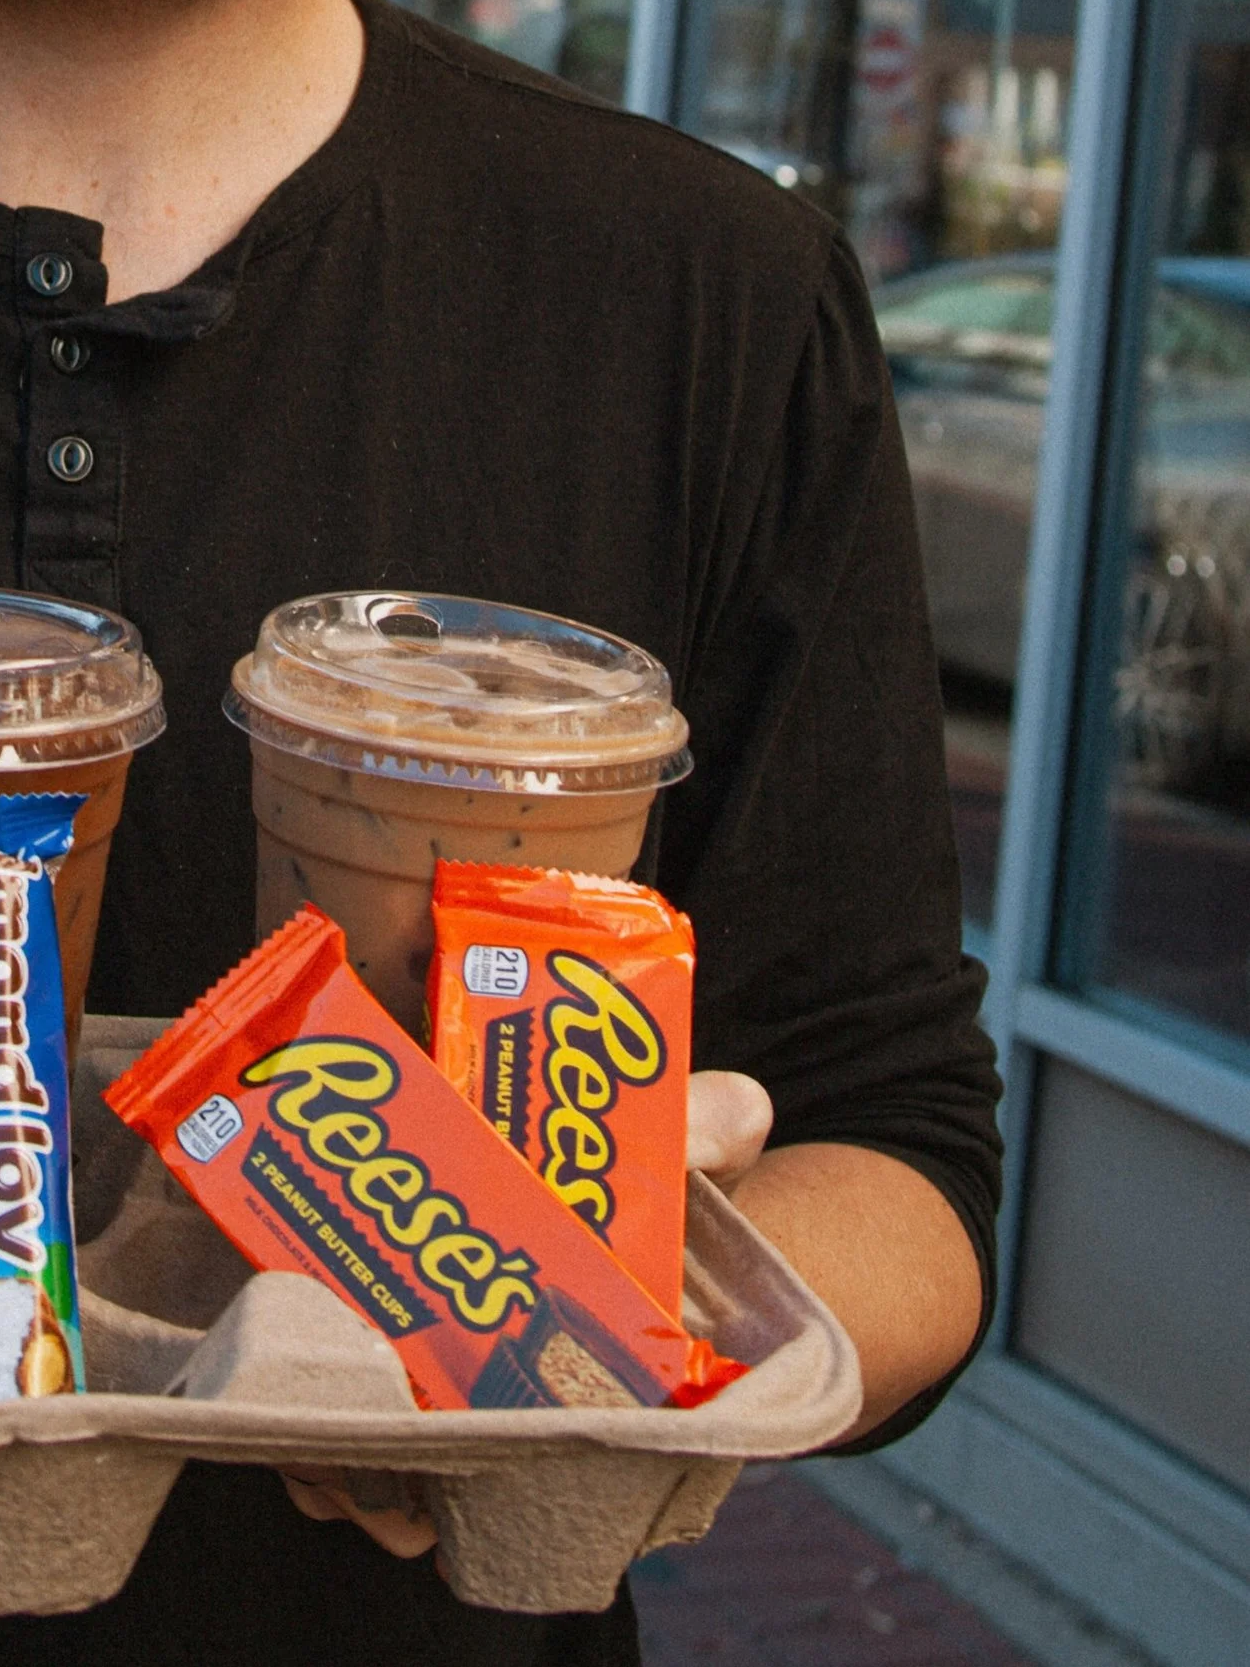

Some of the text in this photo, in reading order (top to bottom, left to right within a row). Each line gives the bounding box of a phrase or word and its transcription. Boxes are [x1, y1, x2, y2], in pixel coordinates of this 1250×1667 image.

[495, 948, 519, 992] 210
[498, 1023, 515, 1036] 2
[495, 1038, 516, 1116] PEANUT
[542, 953, 662, 1222] Rees
[197, 1097, 239, 1140] 210
[239, 1039, 538, 1329] Reese's
[250, 1153, 269, 1169] 2
[262, 1162, 323, 1230] PEANUT
[315, 1224, 376, 1288] BUTTER
[370, 1283, 414, 1330] CUPS
